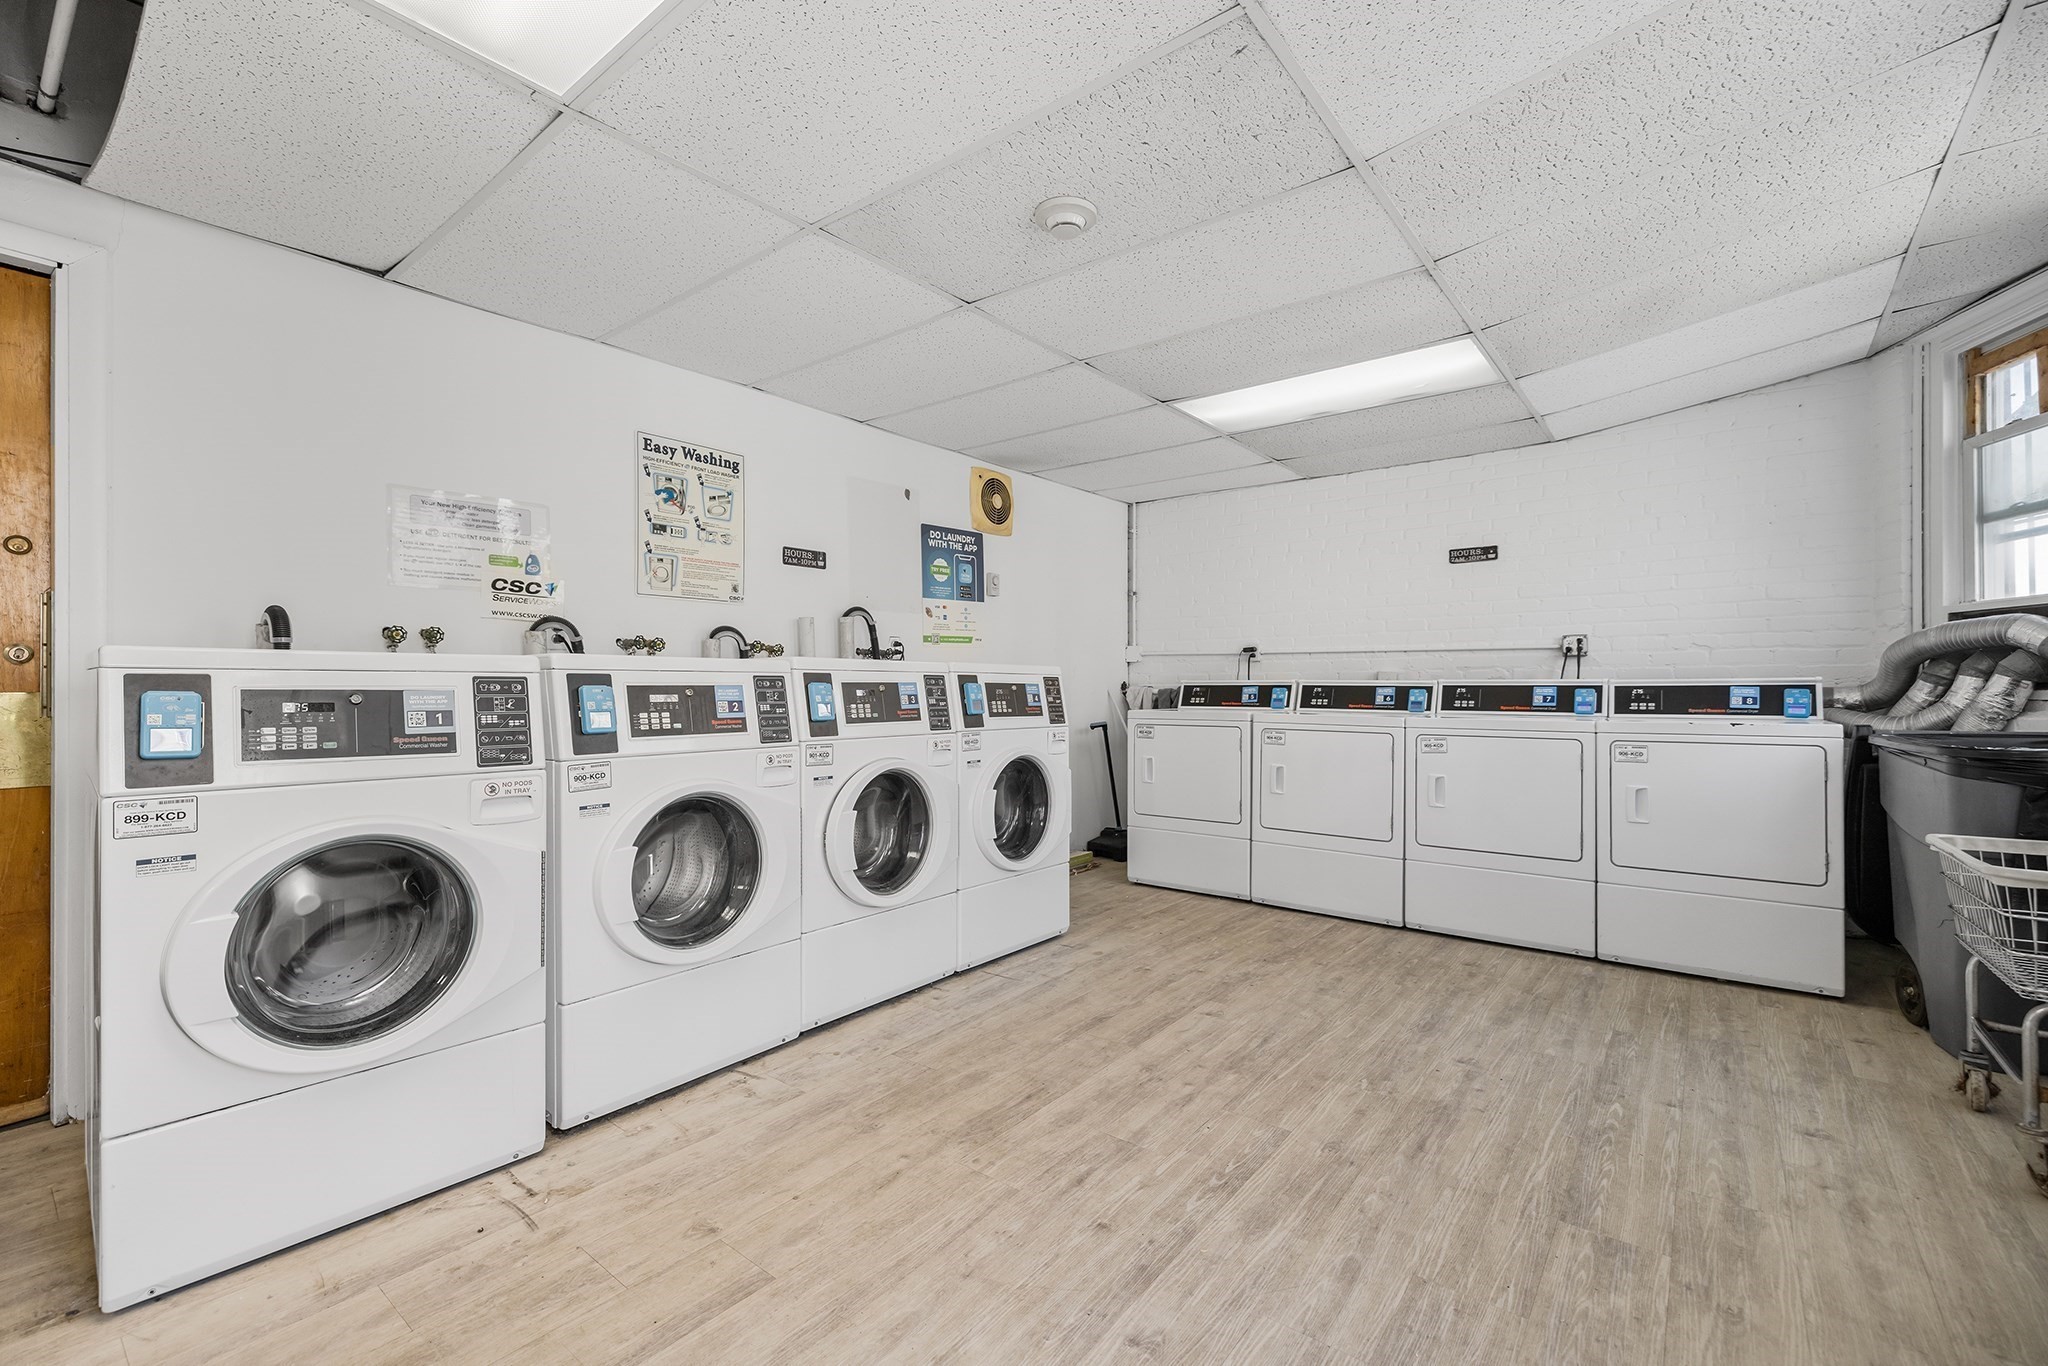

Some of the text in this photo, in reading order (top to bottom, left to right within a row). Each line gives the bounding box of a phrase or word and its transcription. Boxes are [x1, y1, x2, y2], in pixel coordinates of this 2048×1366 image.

[643, 437, 678, 460] Easy
[681, 446, 740, 474] Washing
[643, 455, 684, 468] HIGH-EFFICIENCY
[720, 472, 740, 480] WASHER
[930, 530, 976, 544] DO LAUNDRY
[928, 538, 978, 553] WITH THE APP
[784, 549, 815, 559] HOURS:
[1450, 548, 1484, 557] HOURS:
[491, 578, 542, 594] CSC
[910, 695, 916, 703] 3
[1746, 697, 1753, 705] 8
[732, 702, 739, 711] 2
[435, 712, 443, 725] 1
[573, 772, 606, 782] 900-KCD
[124, 811, 187, 825] 899-KCD
[151, 856, 182, 864] NOTICE
